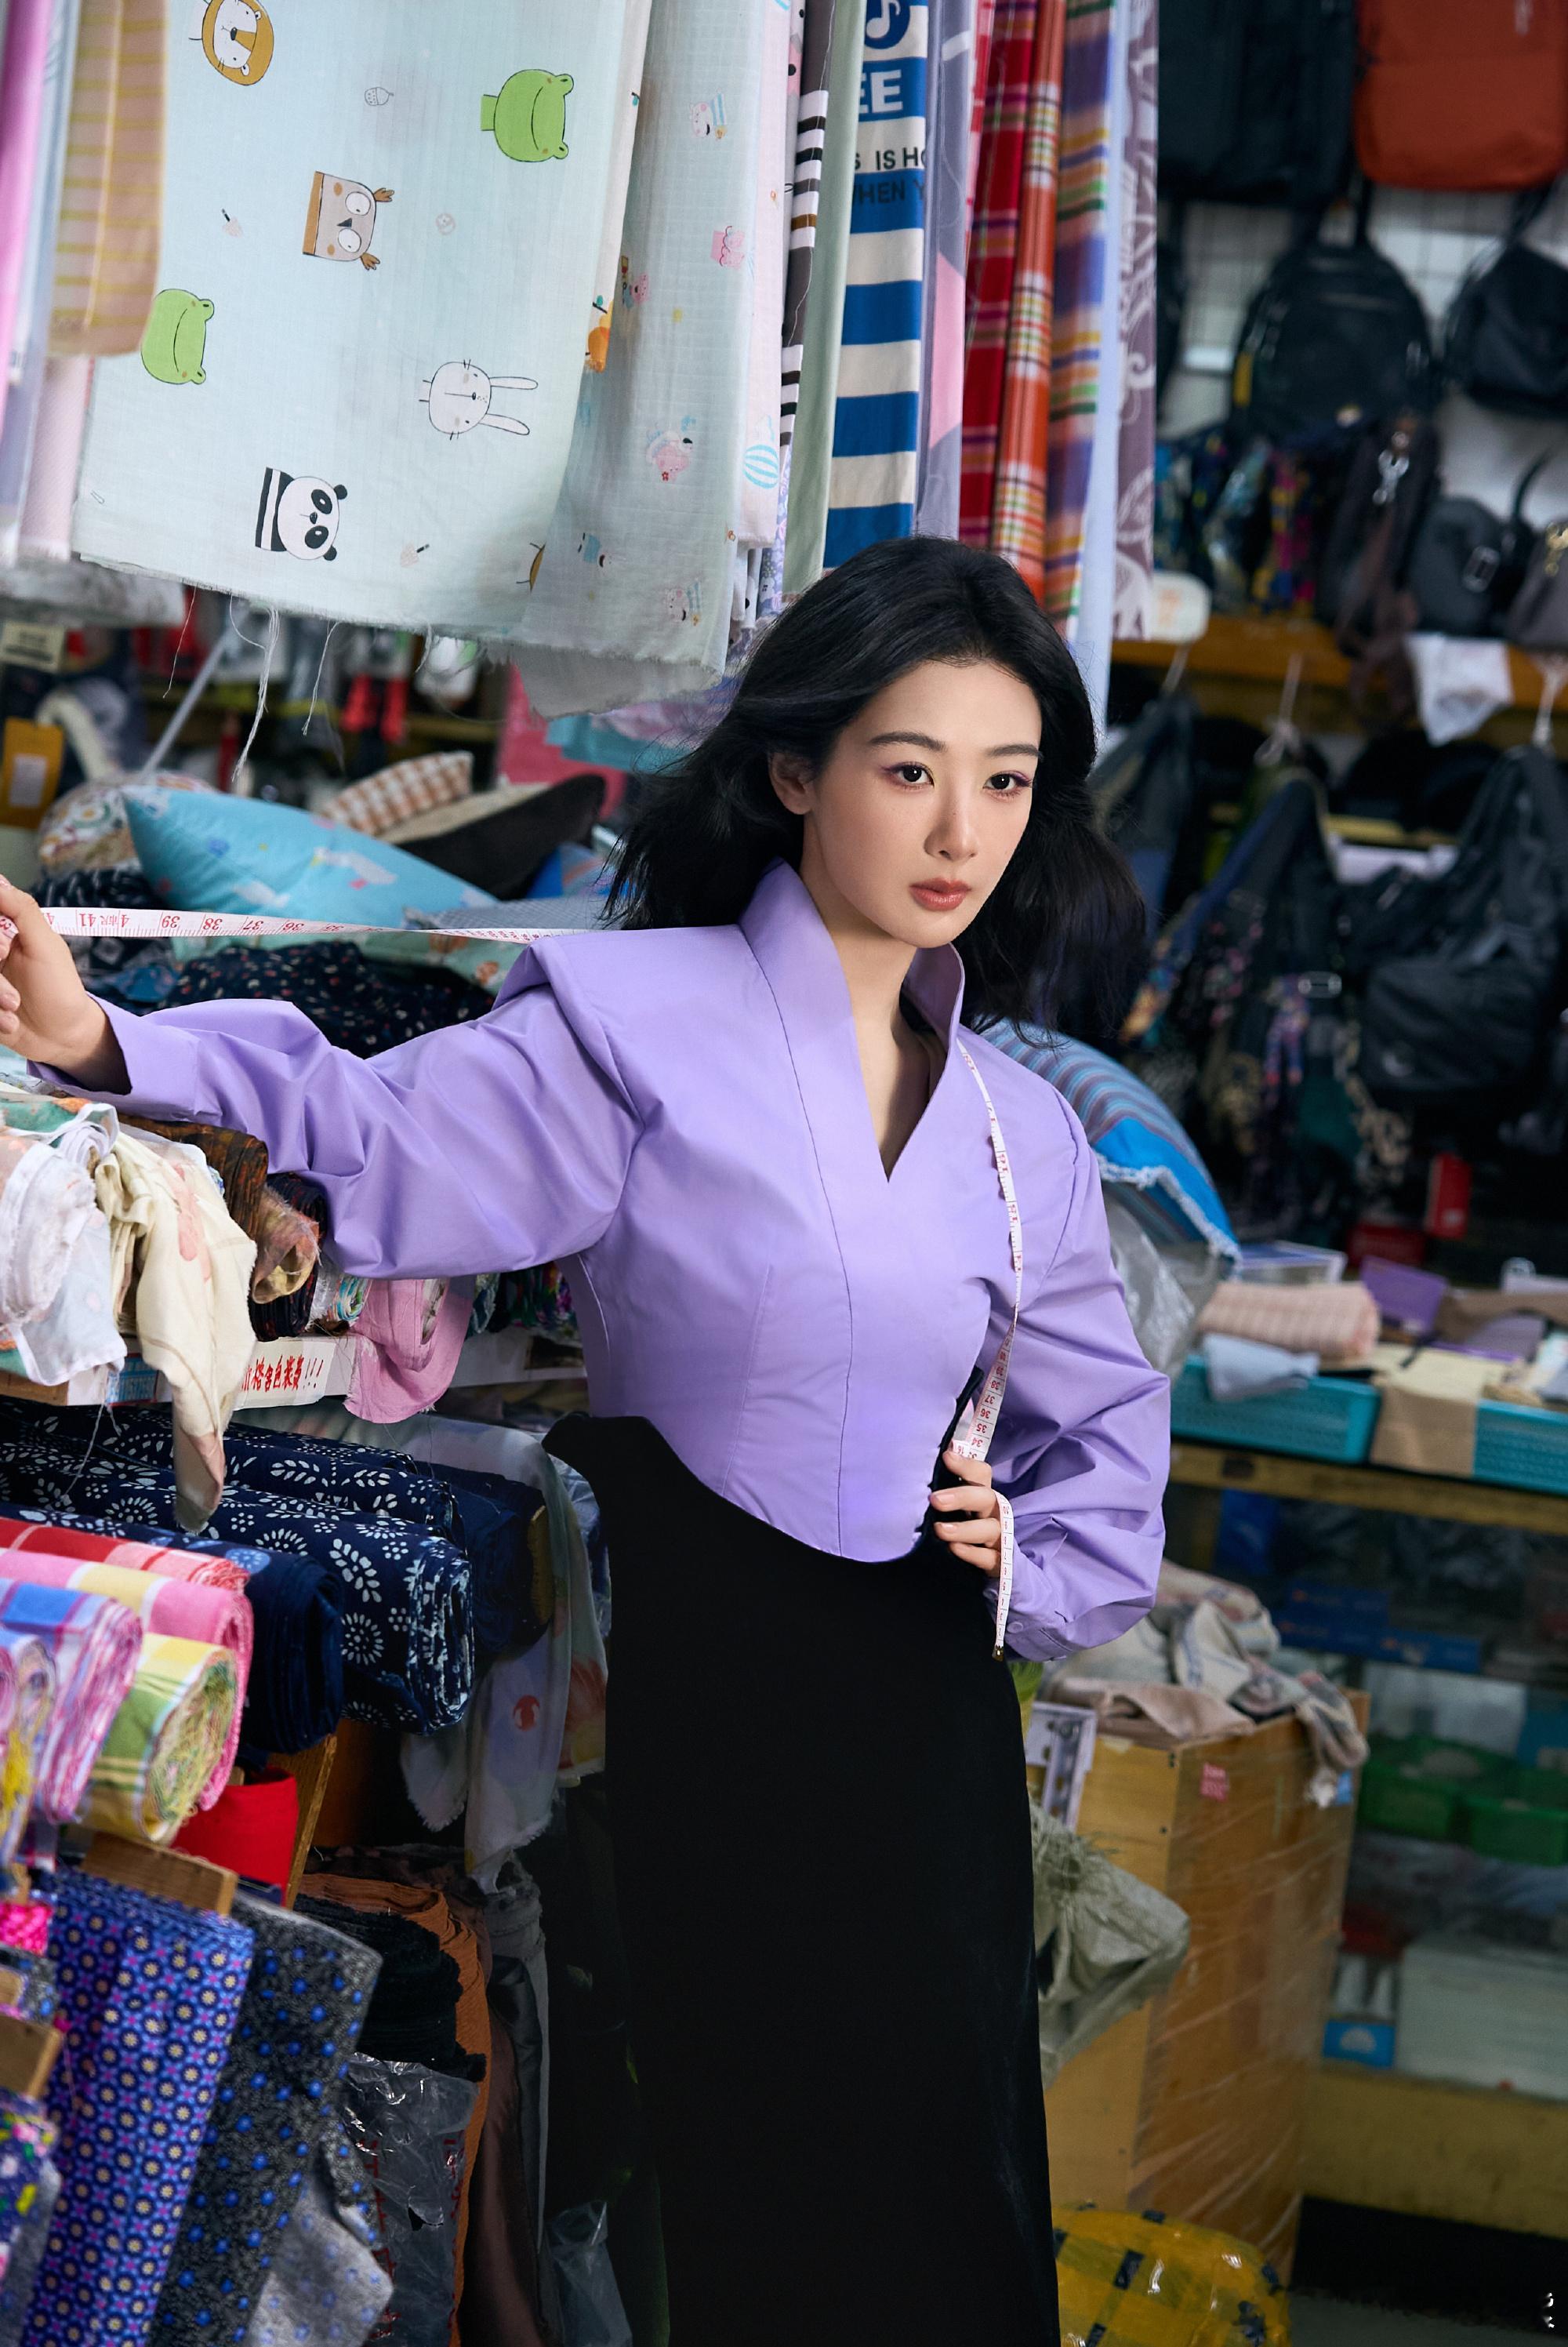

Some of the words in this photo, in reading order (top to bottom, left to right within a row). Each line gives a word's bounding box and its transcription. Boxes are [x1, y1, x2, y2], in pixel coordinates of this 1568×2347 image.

[859, 69, 903, 114] E
[876, 150, 896, 170] IS
[852, 178, 906, 205] HEN
[162, 915, 180, 928] 39
[203, 917, 223, 931] 38
[243, 921, 264, 931] 37
[282, 922, 304, 932] 36
[990, 1381, 1000, 1390] 38
[985, 1396, 996, 1404] 37
[981, 1409, 991, 1419] 36
[976, 1423, 987, 1433] 35
[971, 1437, 983, 1448] 34
